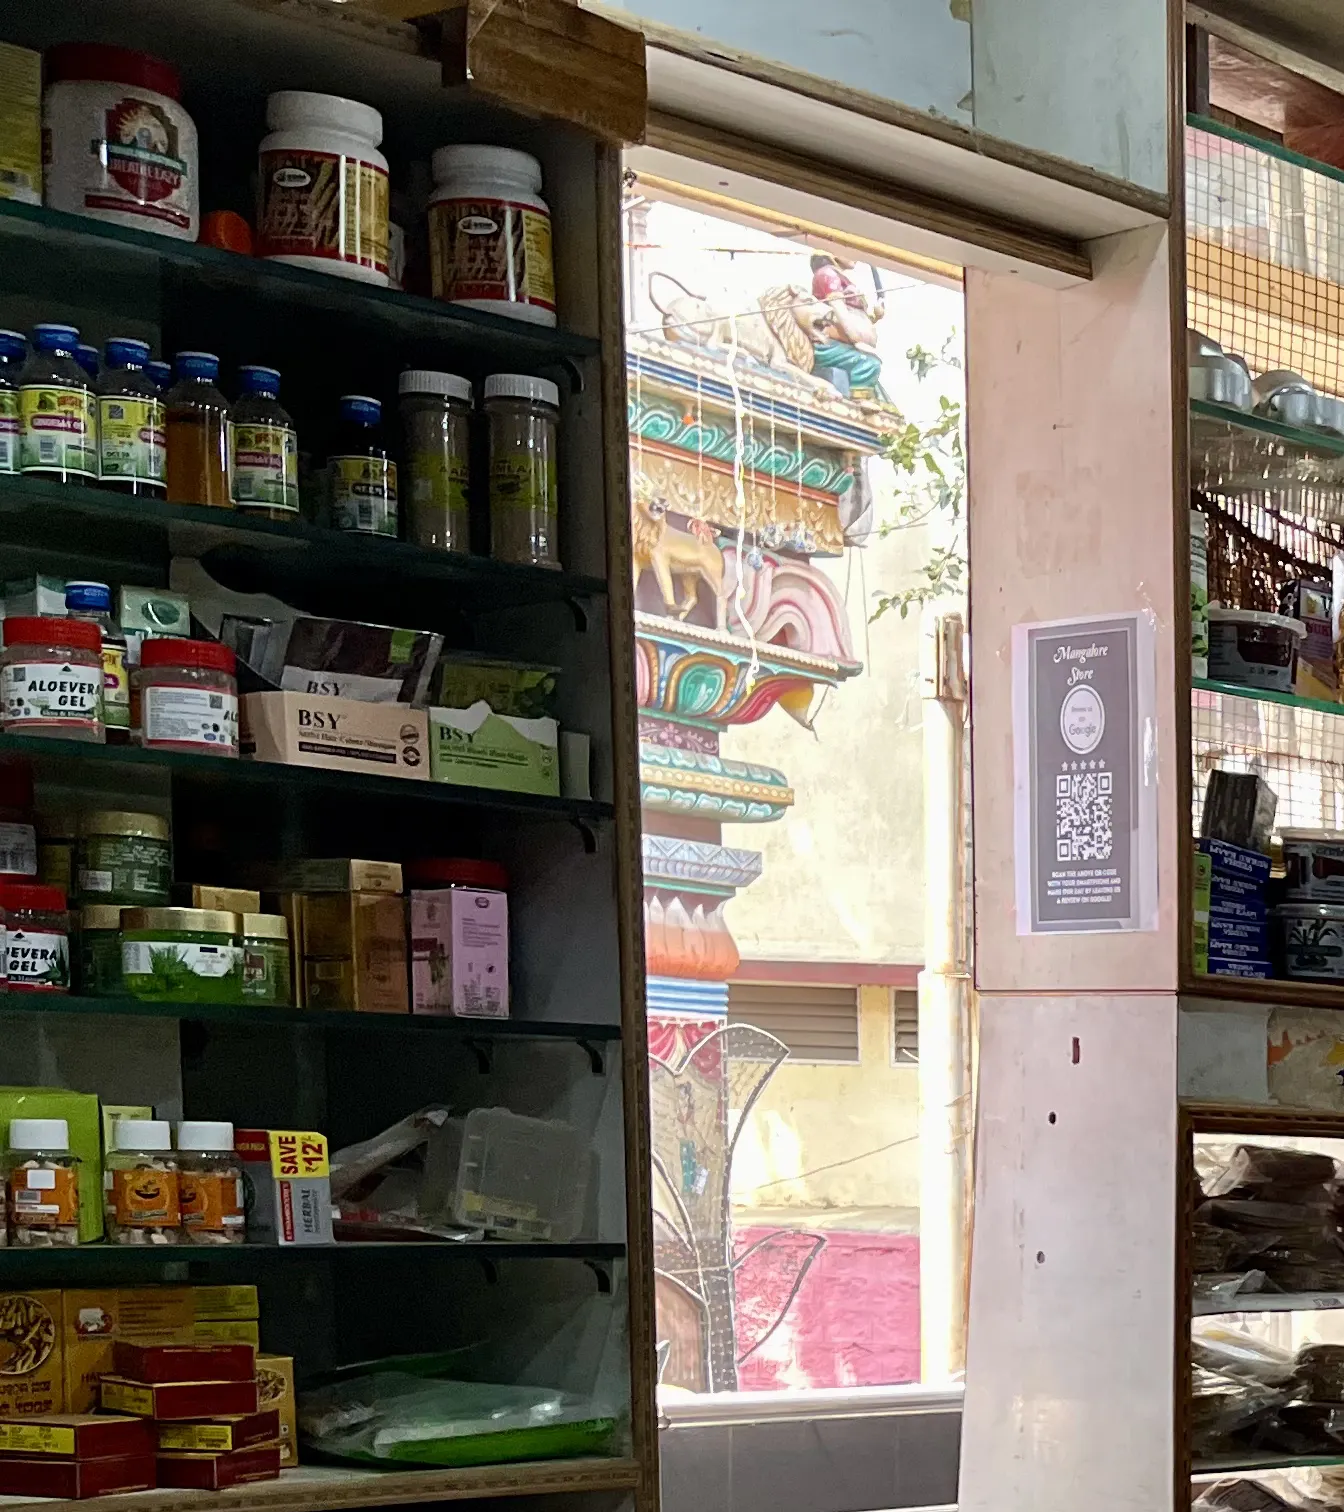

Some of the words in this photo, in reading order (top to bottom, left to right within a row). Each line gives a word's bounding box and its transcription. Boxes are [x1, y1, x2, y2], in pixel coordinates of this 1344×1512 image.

[1053, 644, 1109, 663] Mangalore
[1067, 666, 1094, 686] Store
[307, 681, 340, 697] BSY
[58, 695, 86, 707] GEL
[298, 709, 341, 729] BSY
[439, 727, 475, 744] BSY
[1069, 722, 1097, 739] Google
[8, 947, 57, 961] EVERA
[9, 961, 38, 973] GEL
[279, 1135, 298, 1175] SAVE
